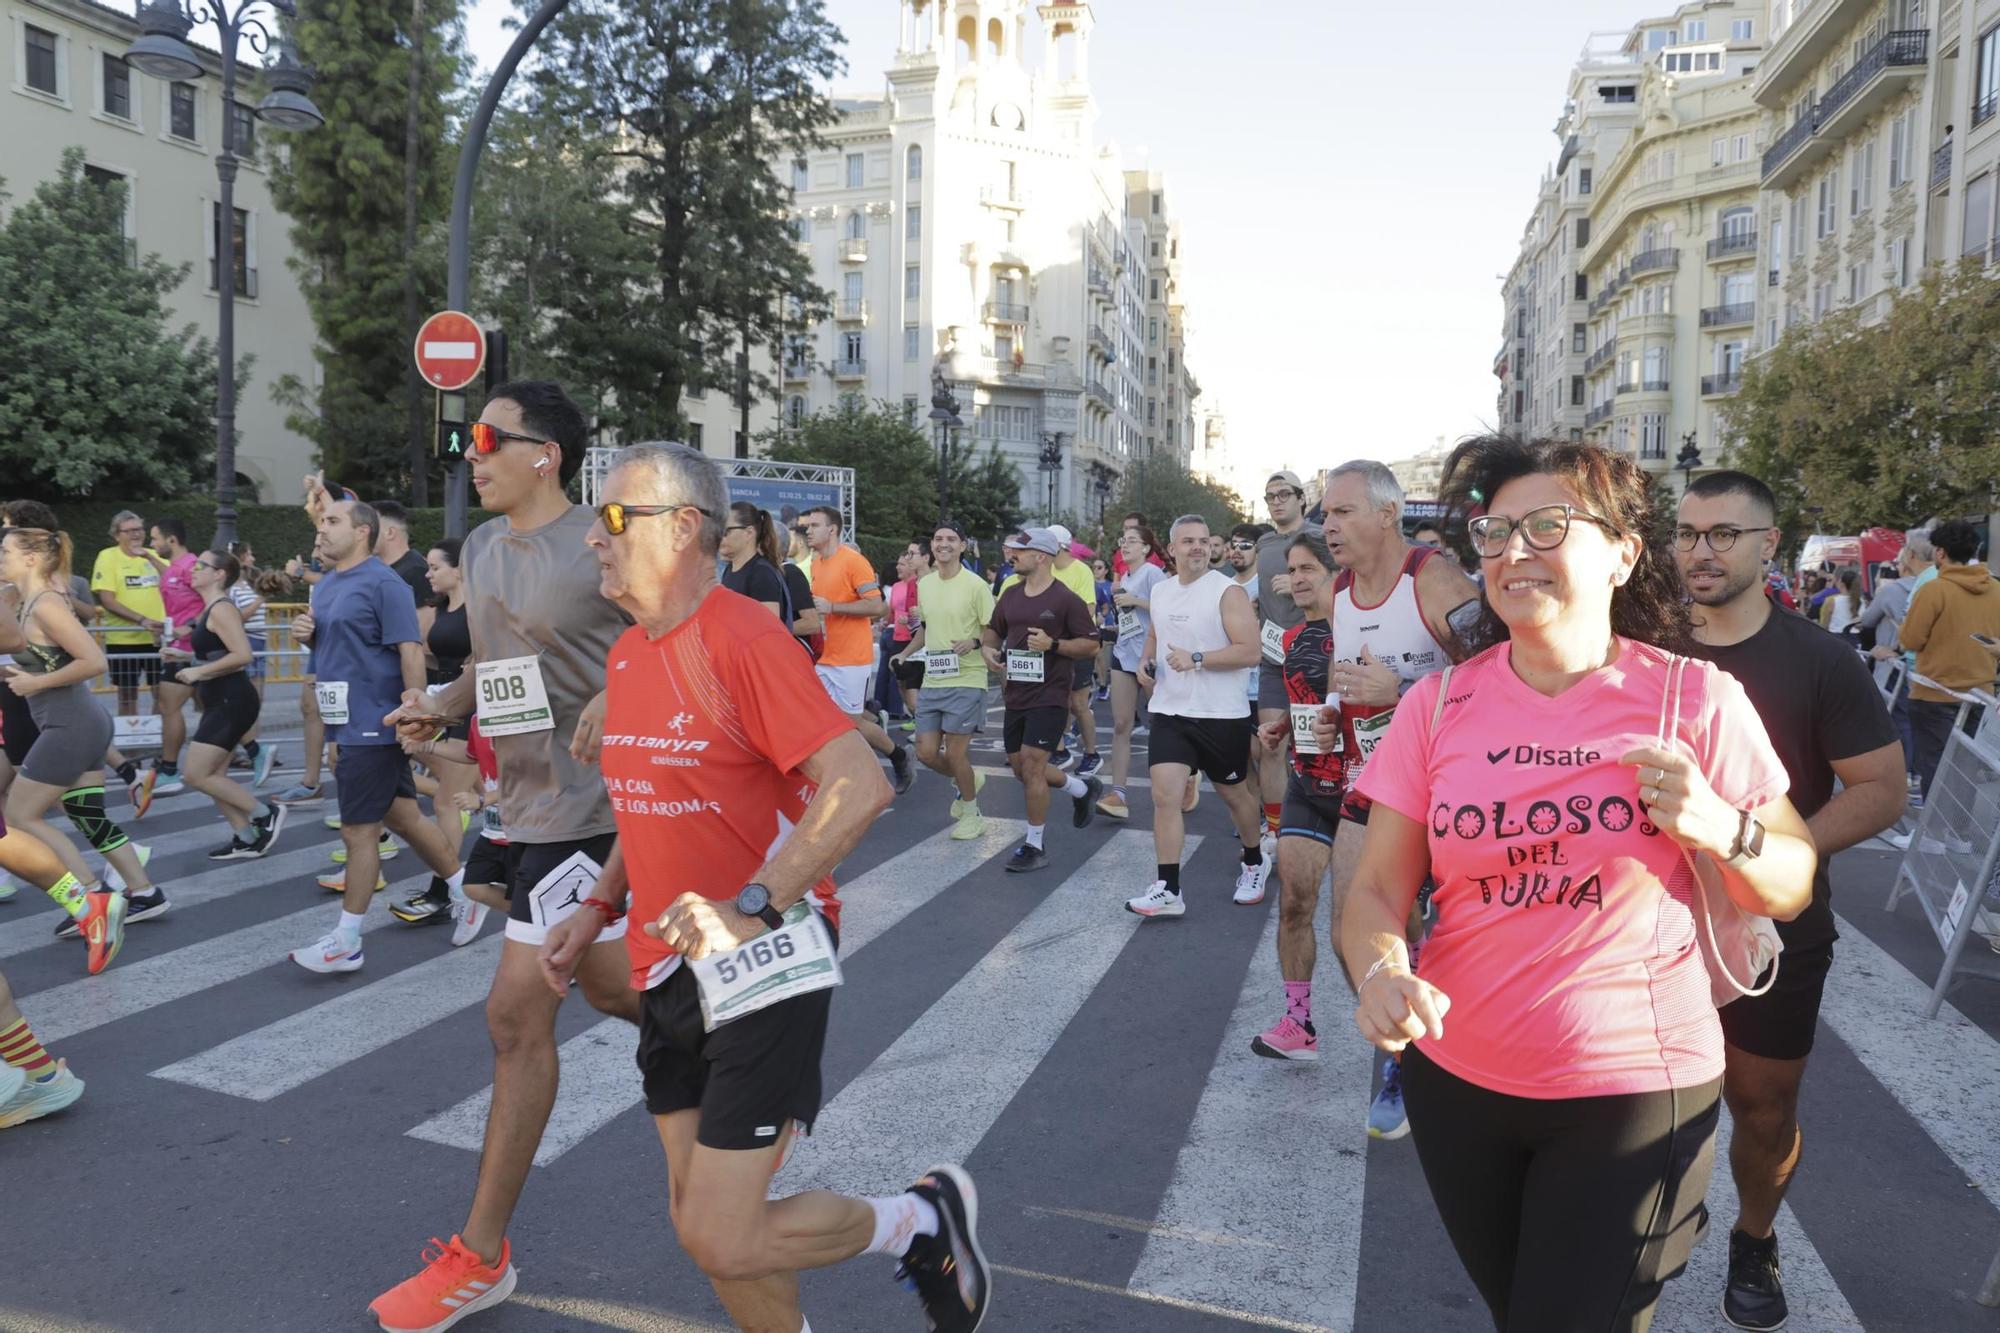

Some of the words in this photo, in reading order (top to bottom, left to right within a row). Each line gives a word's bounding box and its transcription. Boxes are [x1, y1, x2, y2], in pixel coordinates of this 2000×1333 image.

[929, 658, 951, 667] 5660
[1011, 660, 1034, 670] 5661
[482, 675, 526, 703] 908
[601, 735, 636, 747] OTA
[1514, 745, 1601, 766] Disate
[626, 779, 656, 795] CASA
[627, 799, 649, 814] LOS
[1507, 841, 1569, 867] DEL
[1466, 869, 1603, 912] TURIA
[714, 933, 795, 985] 5166
